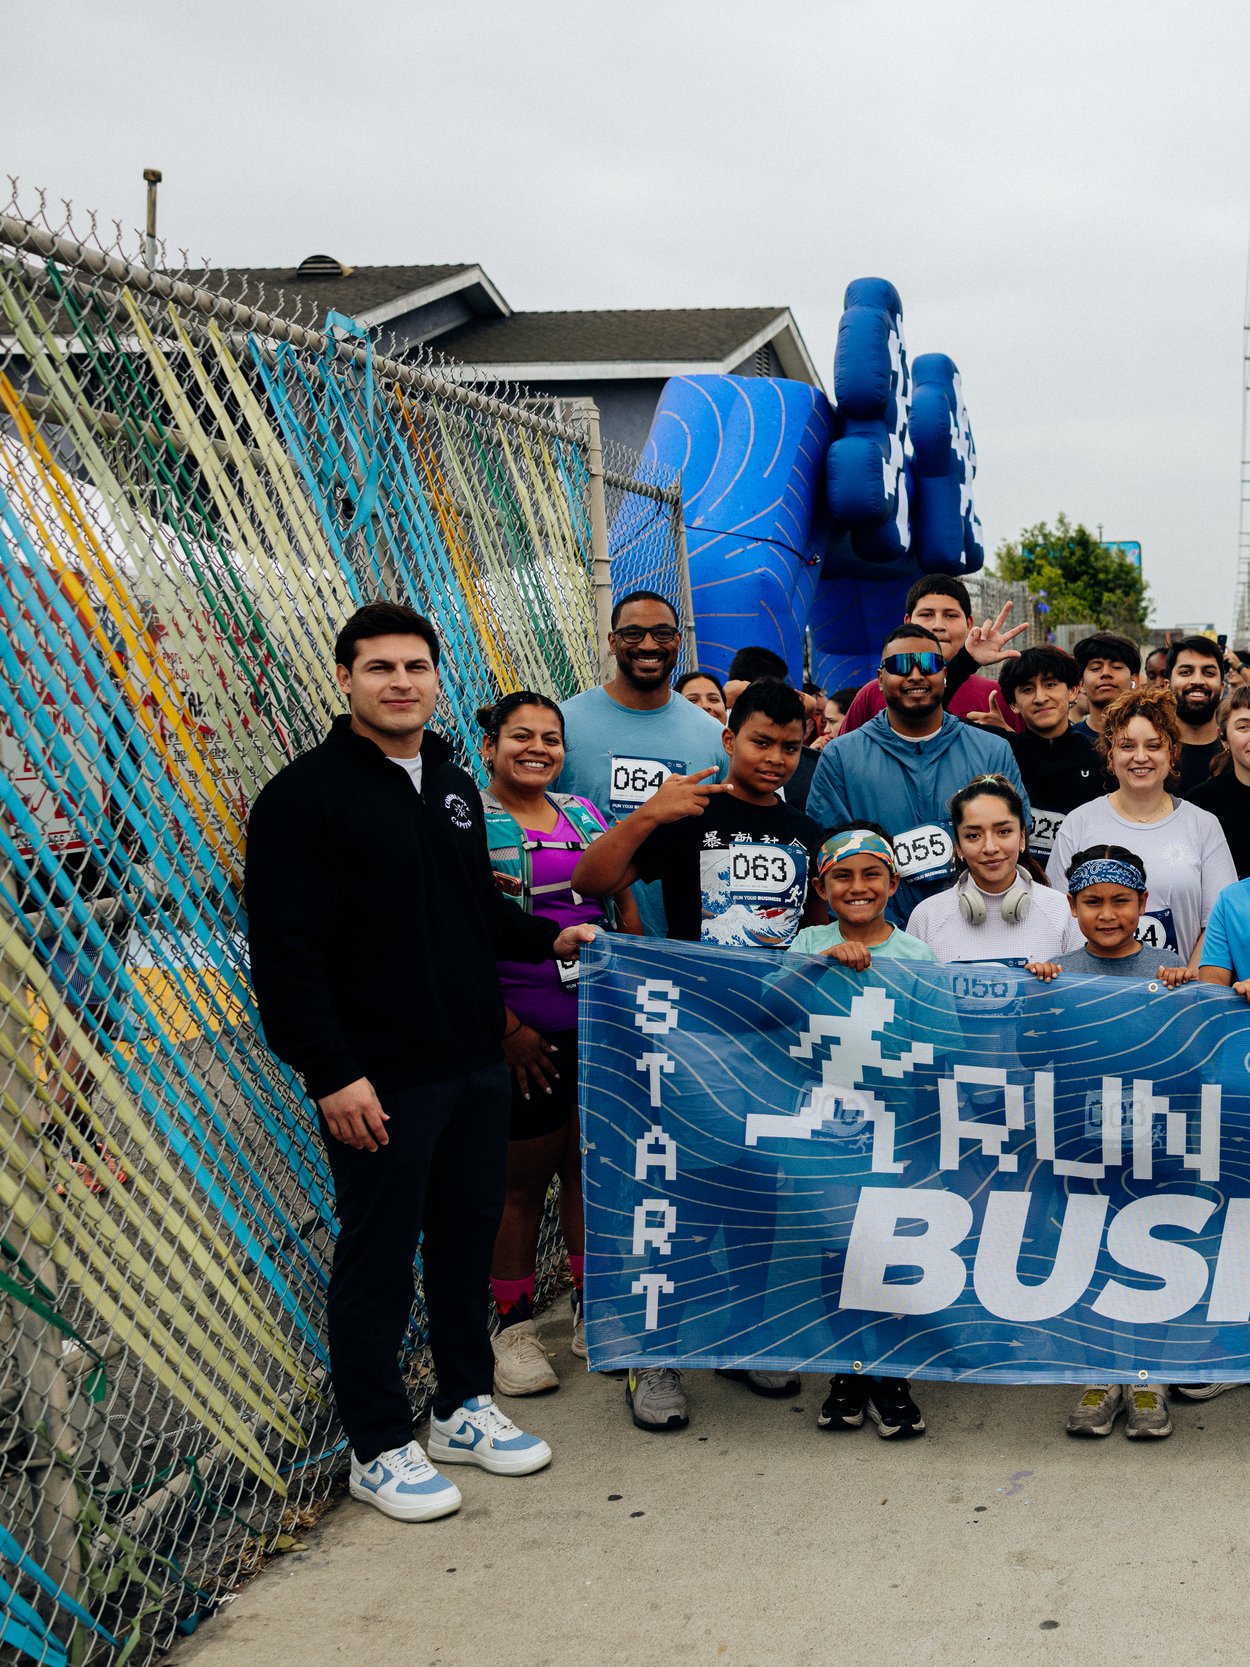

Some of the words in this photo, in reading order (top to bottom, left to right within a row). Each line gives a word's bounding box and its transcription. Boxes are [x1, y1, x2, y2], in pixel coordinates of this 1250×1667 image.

[613, 765, 664, 792] 064
[893, 833, 946, 867] 055
[733, 853, 787, 883] 063
[938, 1064, 1222, 1182] RUN
[632, 979, 680, 1330] START
